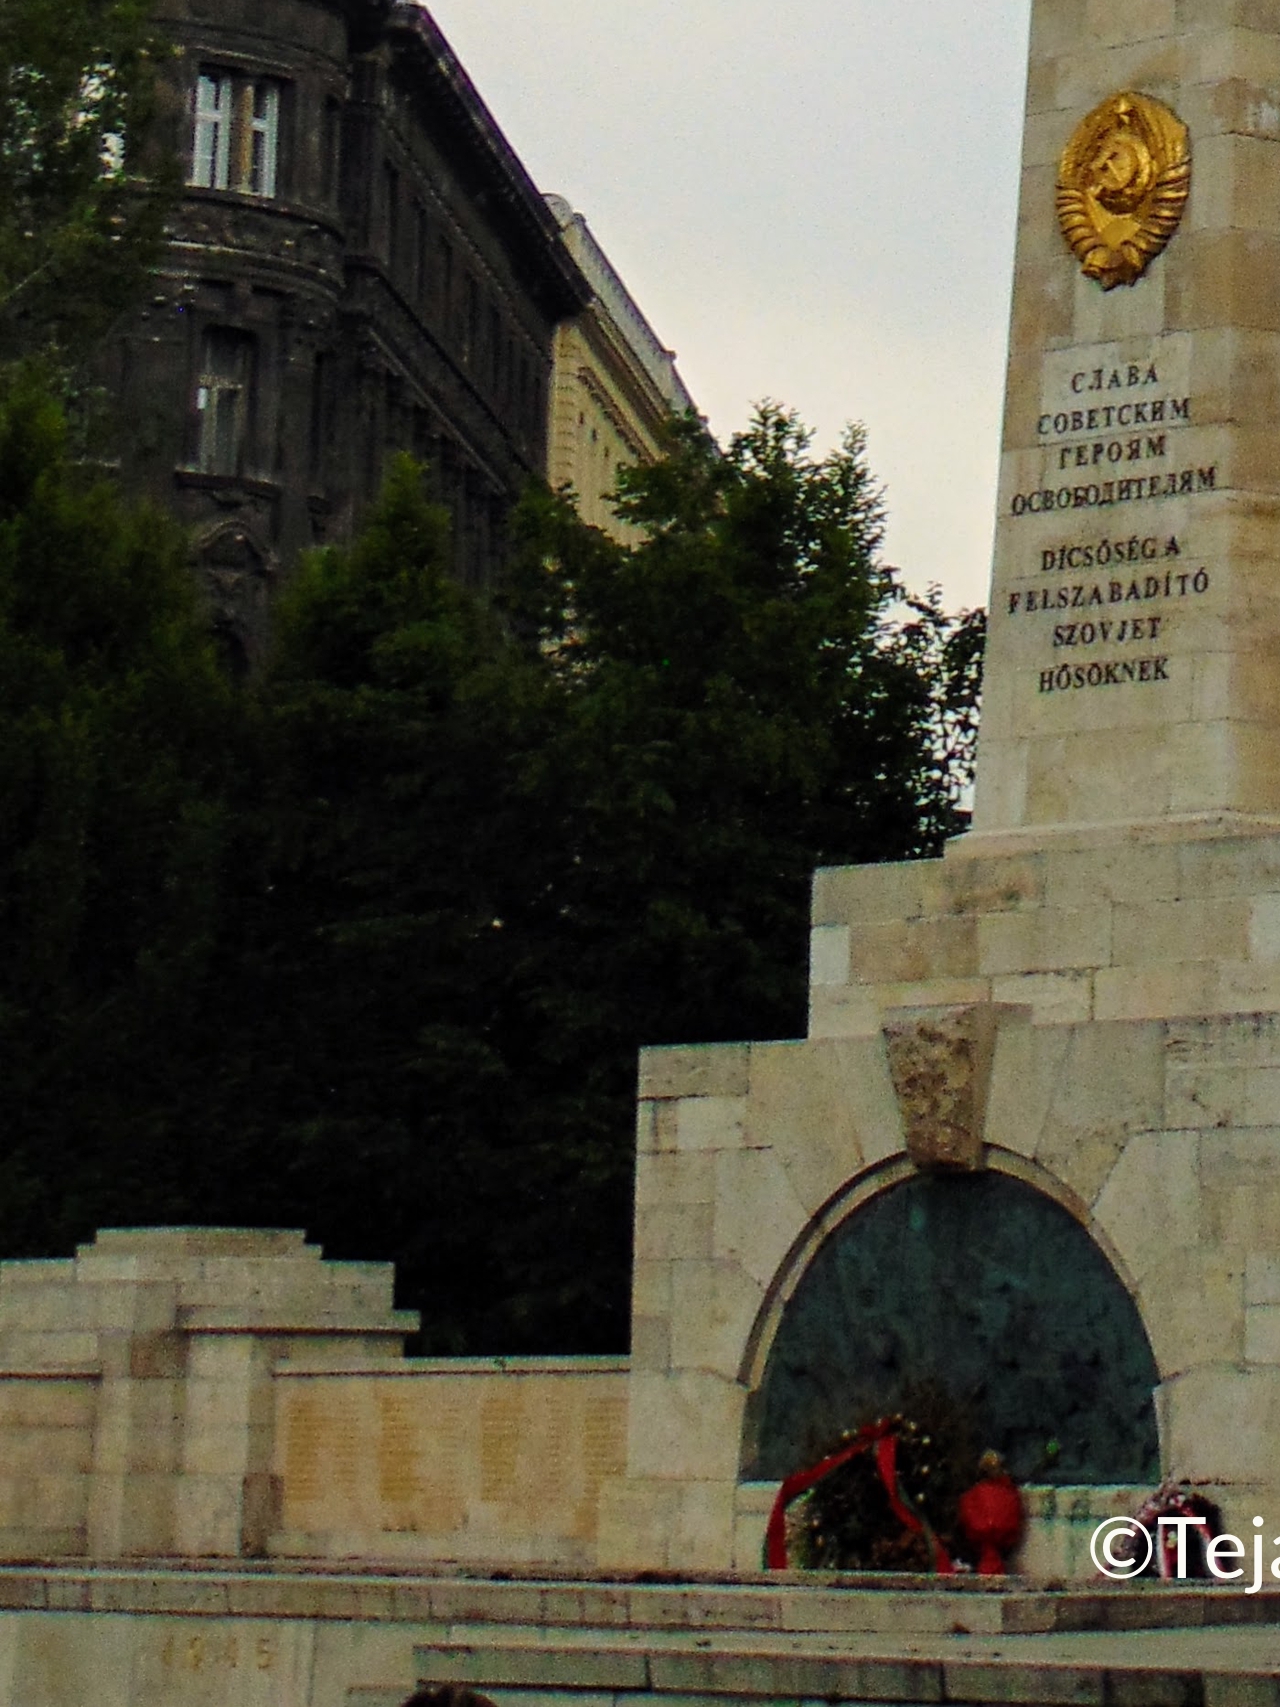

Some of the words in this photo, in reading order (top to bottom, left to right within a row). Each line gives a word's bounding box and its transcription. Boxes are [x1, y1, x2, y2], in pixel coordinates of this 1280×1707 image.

[1071, 364, 1158, 393] СЛАВА
[1059, 435, 1166, 469] ГЕРОЯМ
[1165, 536, 1181, 556] A
[1053, 617, 1161, 647] SZOVJET
